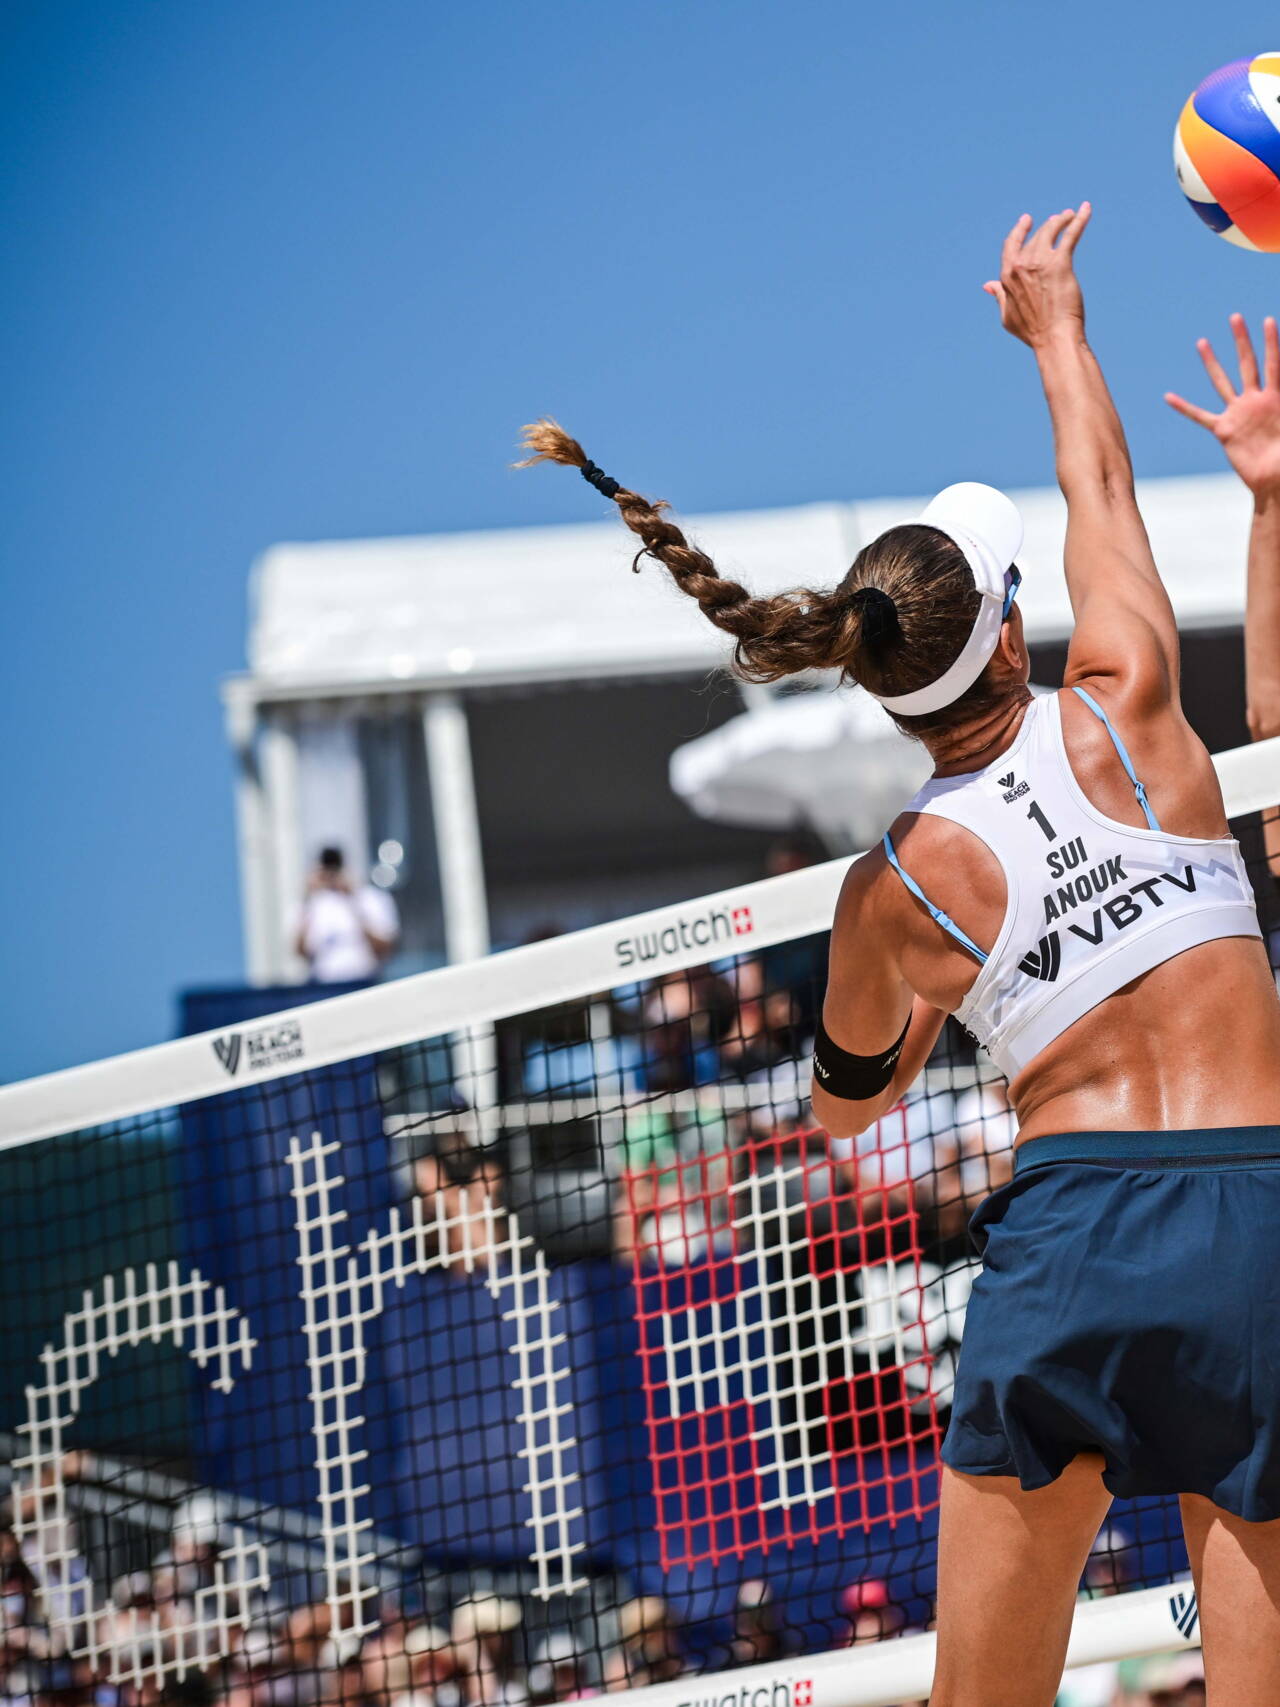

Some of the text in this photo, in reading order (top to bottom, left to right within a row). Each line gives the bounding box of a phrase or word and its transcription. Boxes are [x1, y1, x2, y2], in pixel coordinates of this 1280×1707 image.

[1002, 782, 1029, 801] BEACH
[1026, 800, 1057, 842] 1
[1046, 836, 1088, 879] SUI
[1043, 854, 1128, 925] ANOUK
[1067, 865, 1196, 946] VBTV
[614, 908, 733, 968] swatch
